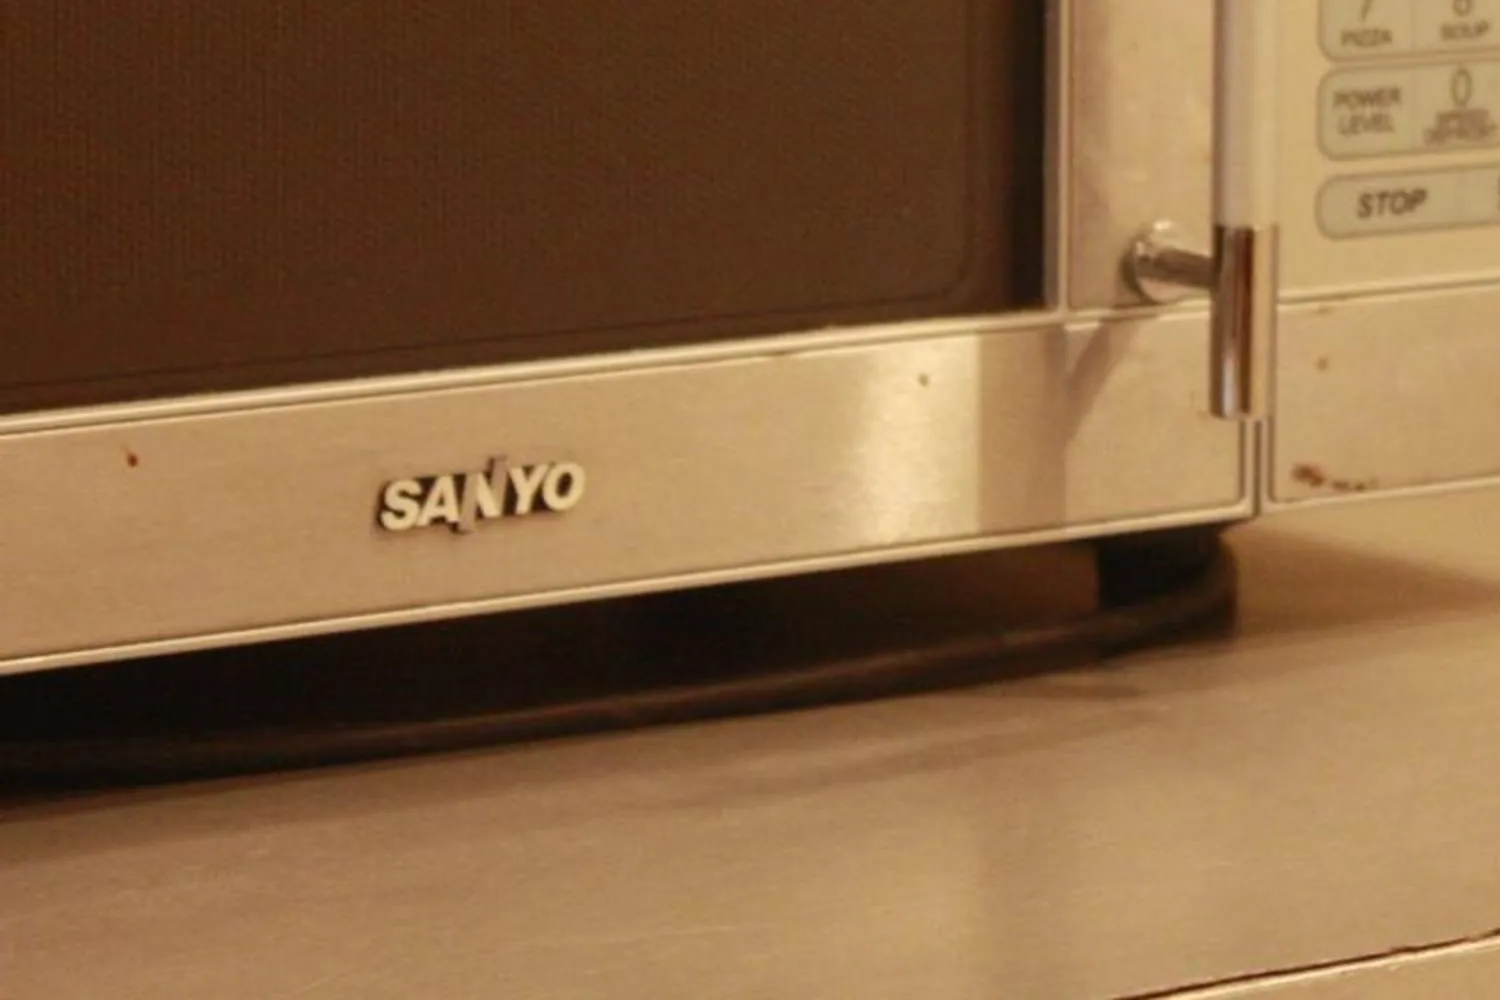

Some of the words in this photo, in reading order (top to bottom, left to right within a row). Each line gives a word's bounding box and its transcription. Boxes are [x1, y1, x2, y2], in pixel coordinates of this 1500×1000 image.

[1440, 20, 1491, 42] SOUP
[1333, 86, 1402, 110] POWER
[1337, 112, 1395, 137] LEVEL
[1356, 188, 1429, 220] STOP
[375, 453, 586, 535] SANYO
